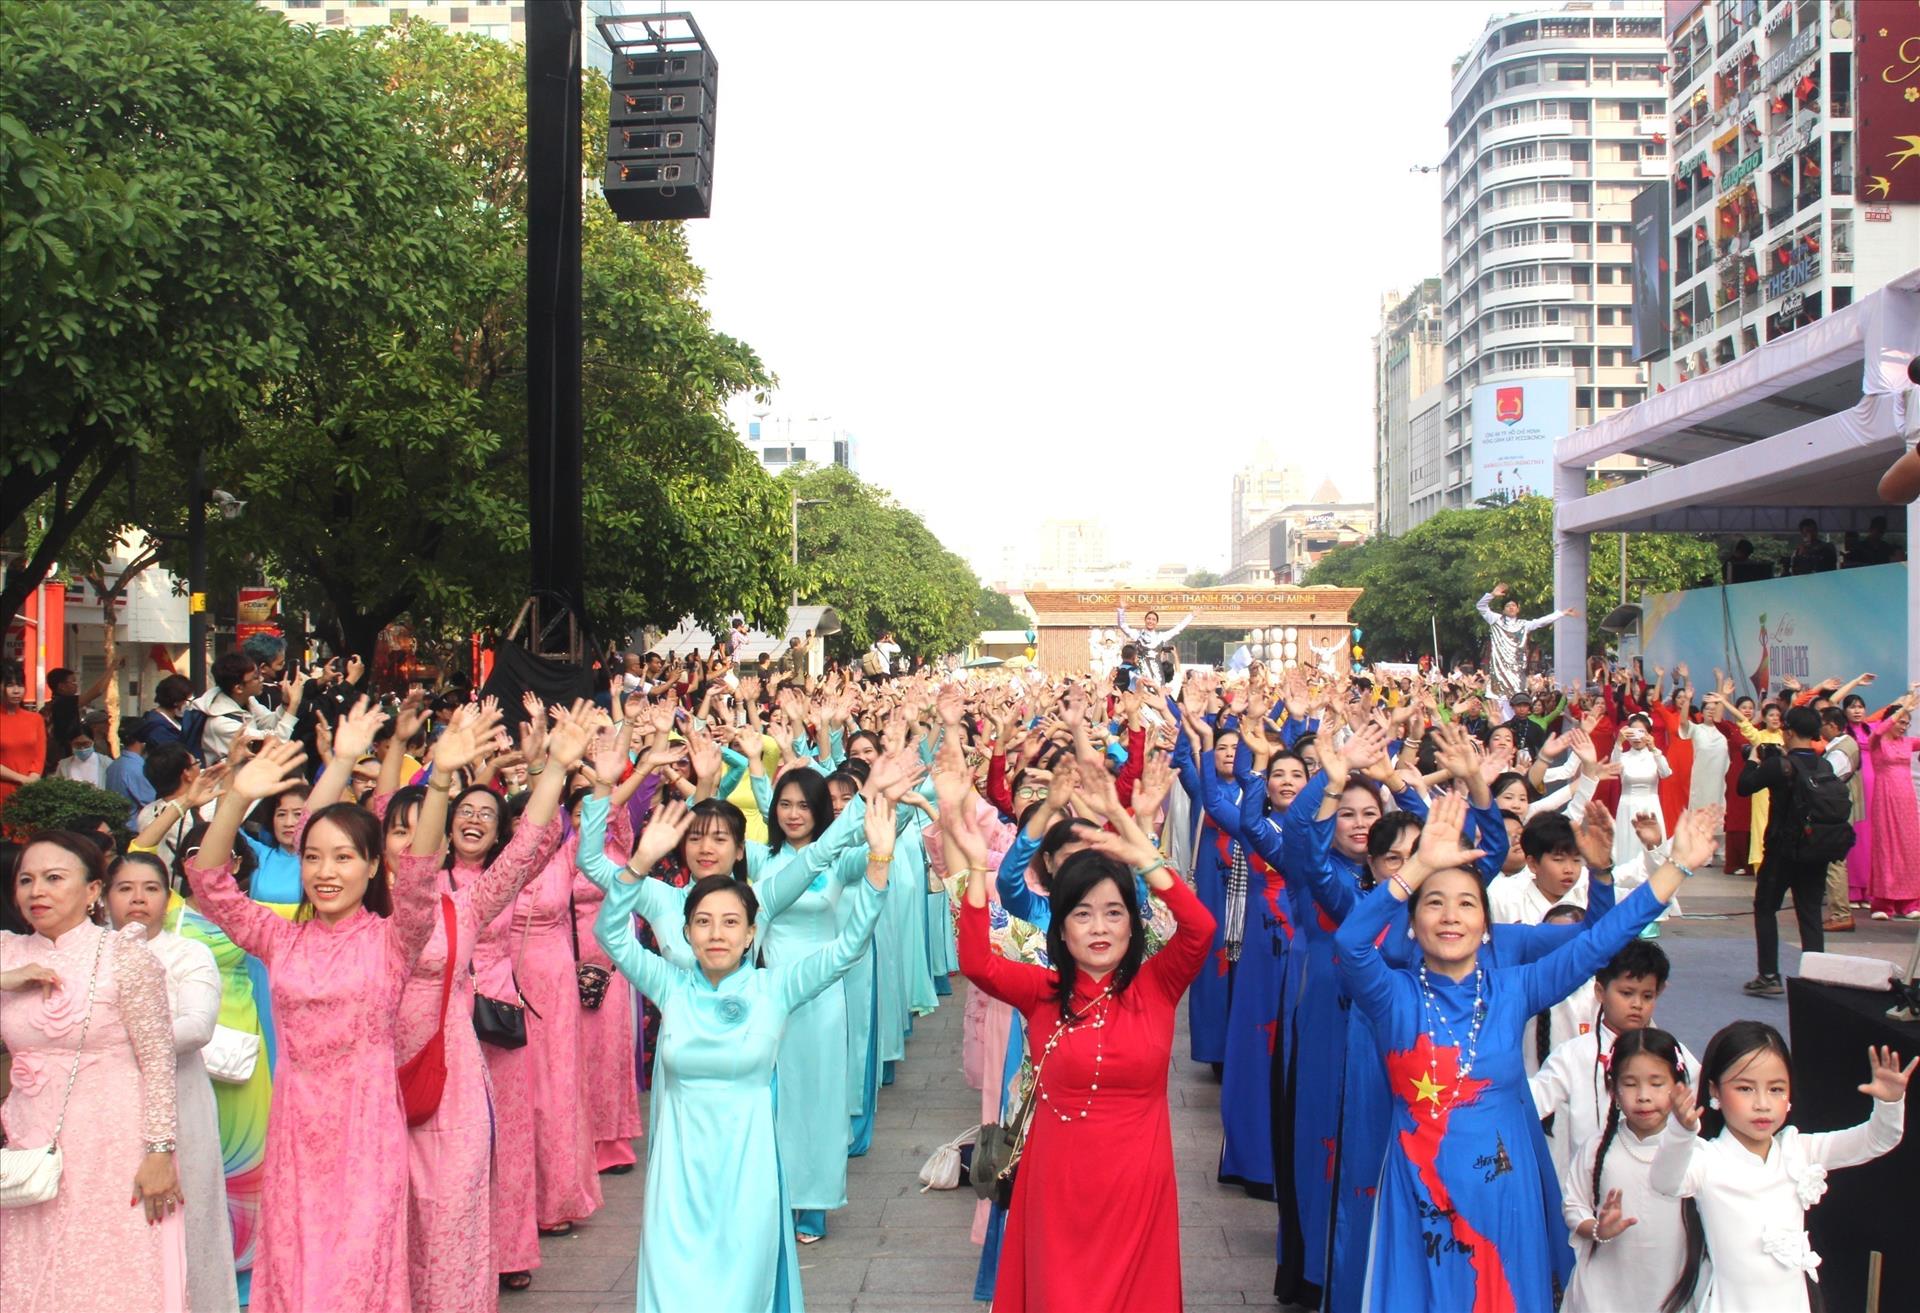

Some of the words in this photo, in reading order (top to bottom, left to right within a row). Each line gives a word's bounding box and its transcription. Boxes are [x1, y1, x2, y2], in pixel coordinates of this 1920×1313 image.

[1768, 270, 1786, 299] THE
[1789, 257, 1811, 288] ONE
[1077, 593, 1116, 604] THÔNG
[1138, 594, 1153, 604] DU
[1286, 594, 1316, 604] MINH
